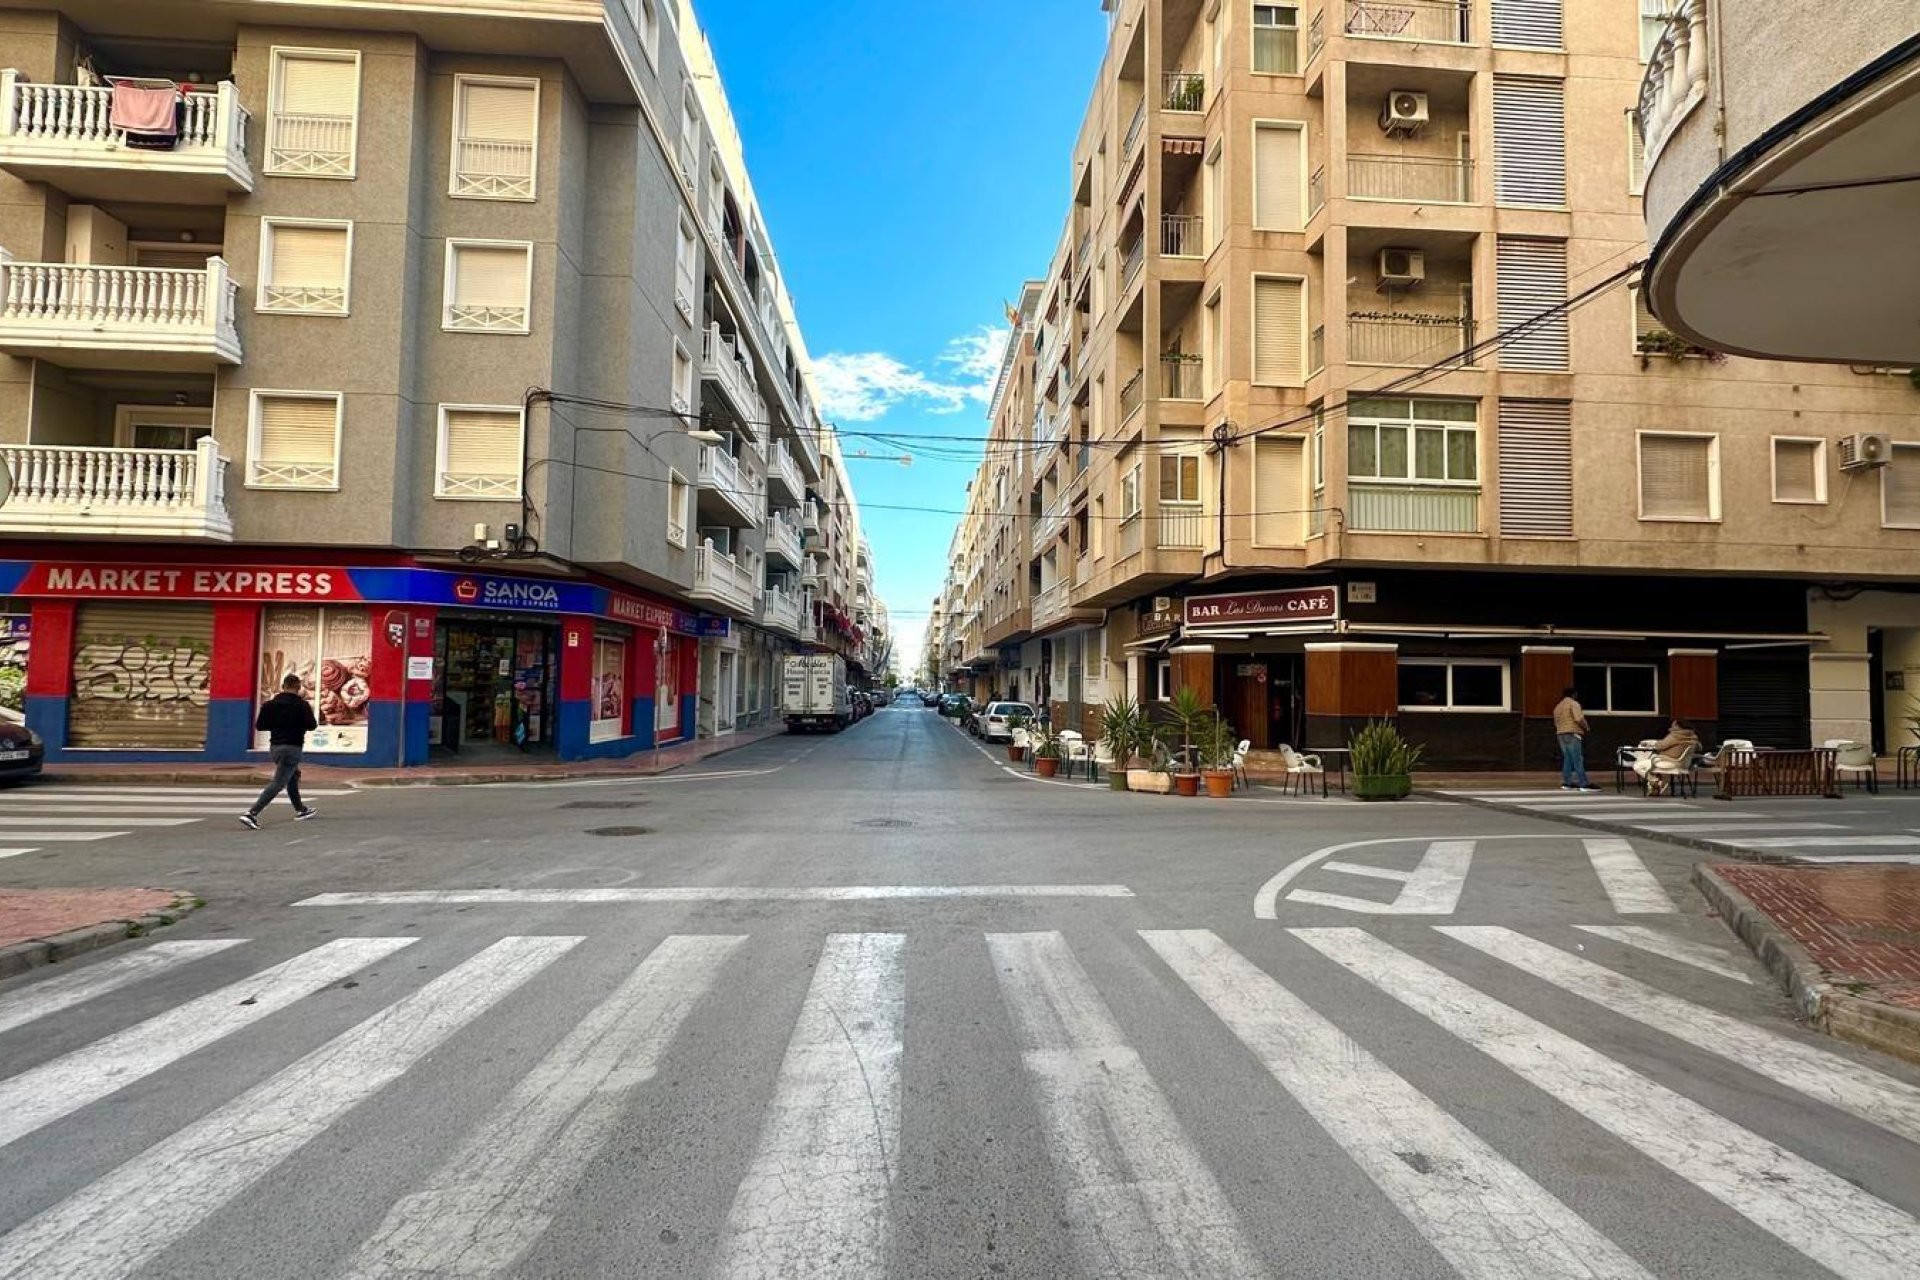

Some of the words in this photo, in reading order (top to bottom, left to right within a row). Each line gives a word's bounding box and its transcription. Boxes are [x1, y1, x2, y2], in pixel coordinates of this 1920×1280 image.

[48, 568, 181, 592] MARKET
[193, 571, 332, 595] EXPRESS
[485, 581, 558, 601] SANOA
[484, 597, 518, 606] MARKET
[522, 599, 559, 608] EXPRESS
[613, 597, 645, 621] MARKET
[646, 605, 673, 627] EXPRESS
[1153, 612, 1181, 622] BAR
[1192, 605, 1220, 617] BAR
